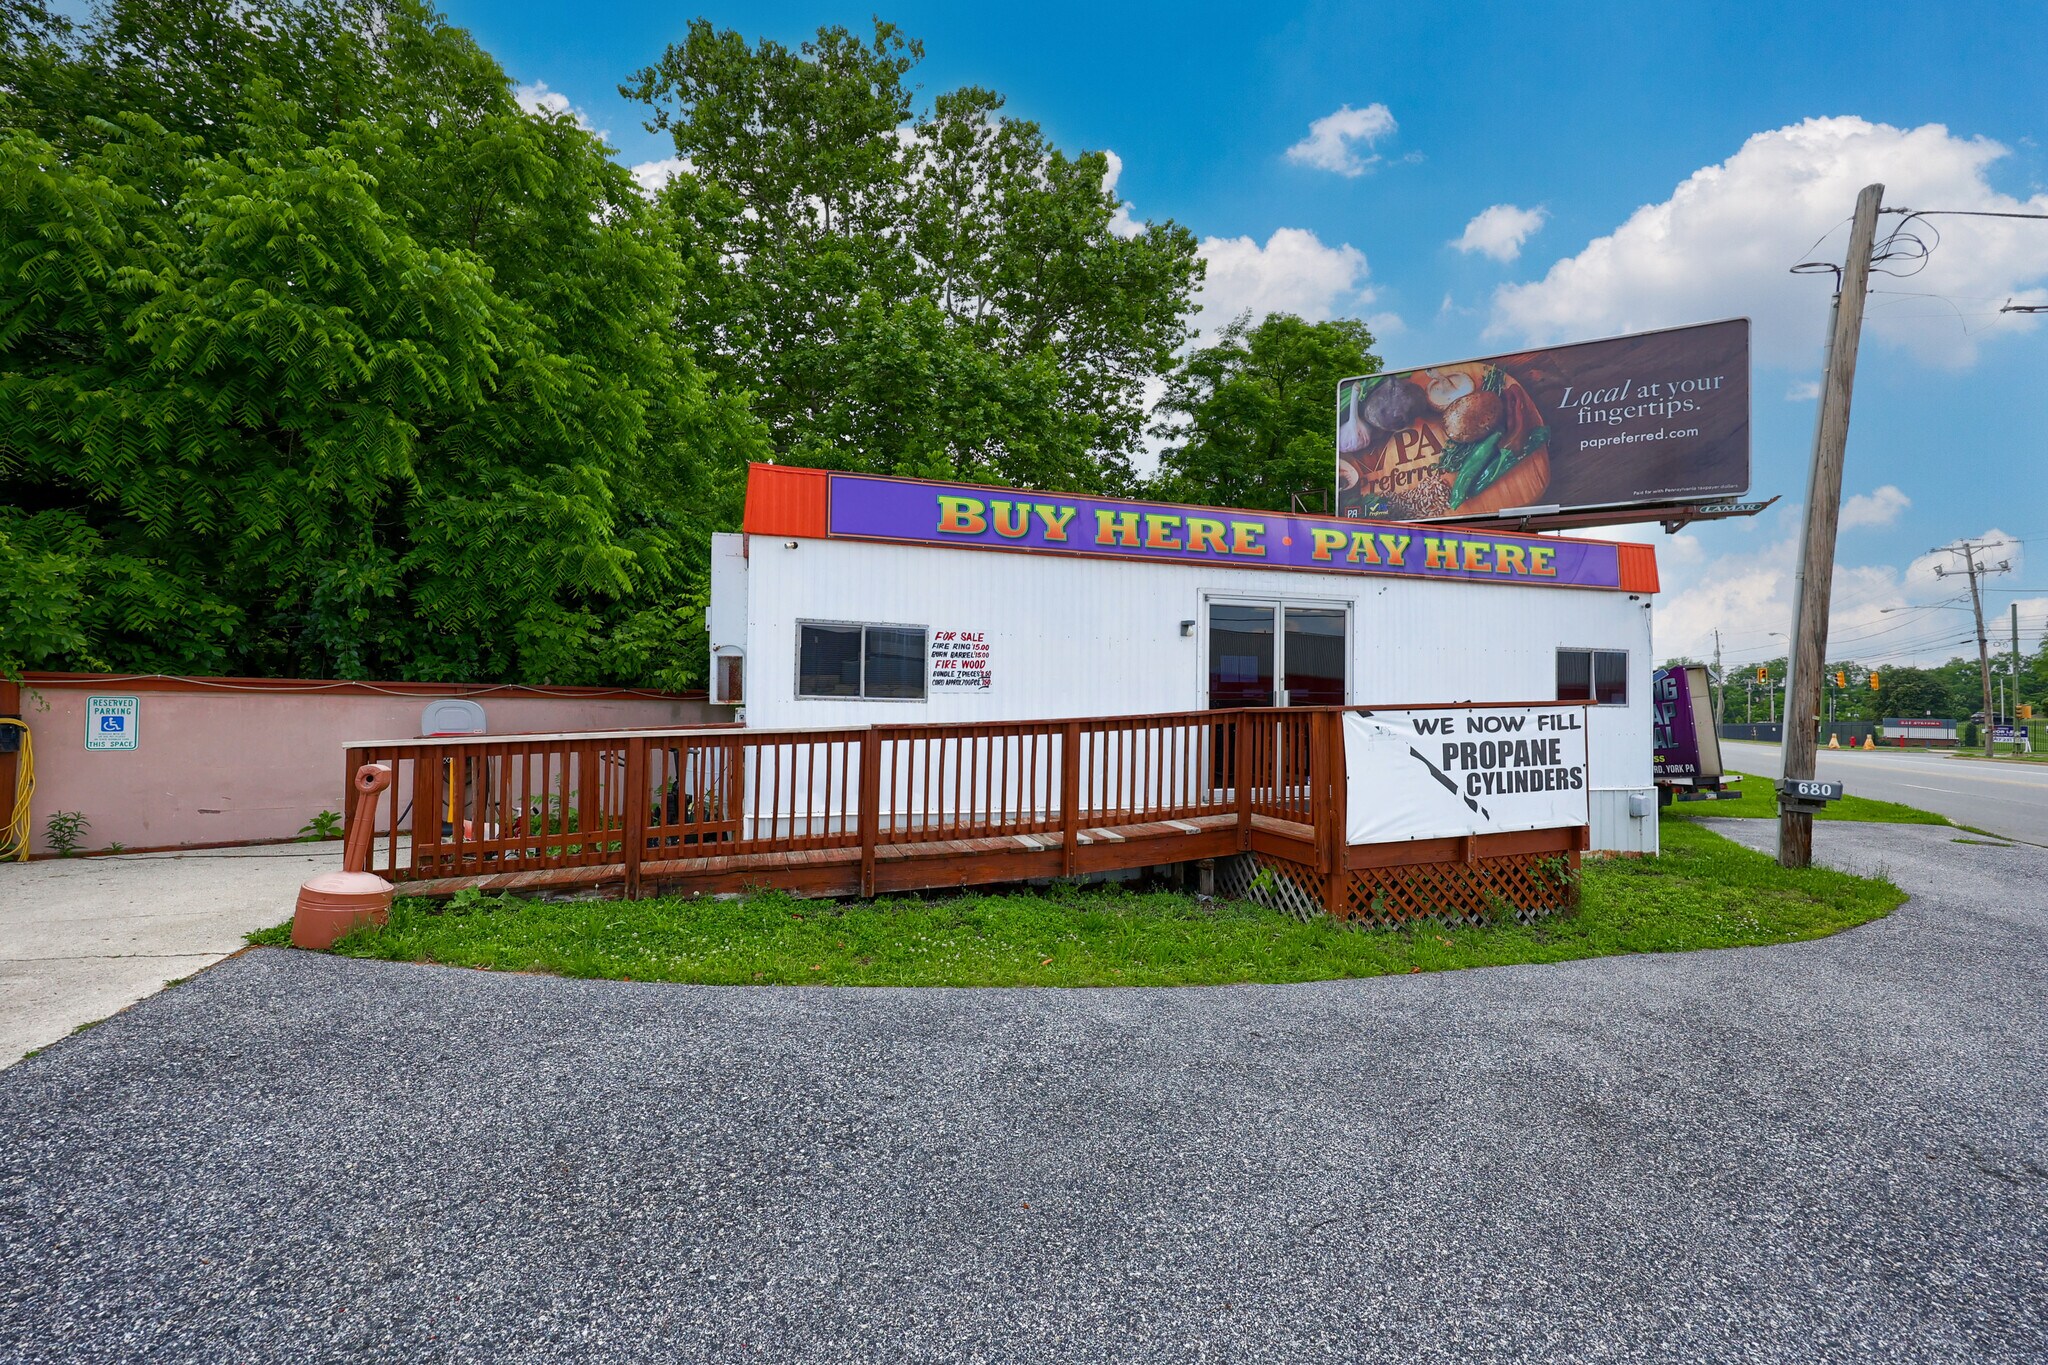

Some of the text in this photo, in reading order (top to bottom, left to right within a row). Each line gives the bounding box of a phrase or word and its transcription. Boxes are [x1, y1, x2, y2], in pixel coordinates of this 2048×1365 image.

[1558, 376, 1724, 409] Local at your
[1577, 398, 1701, 426] fingertips.
[1394, 422, 1443, 466] PA
[1580, 427, 1699, 451] papreferred.com
[936, 495, 1558, 577] BUY HERE PAY HERE
[935, 631, 984, 642] FOR SALE
[935, 660, 986, 669] FIRE WOOD
[1413, 713, 1582, 736] WE NOW FILL
[1442, 738, 1561, 771] PROPANE
[1466, 766, 1583, 797] CYLINDERS
[1666, 764, 1684, 773] YORK
[1685, 764, 1695, 773] PA
[1798, 783, 1832, 796] 680
